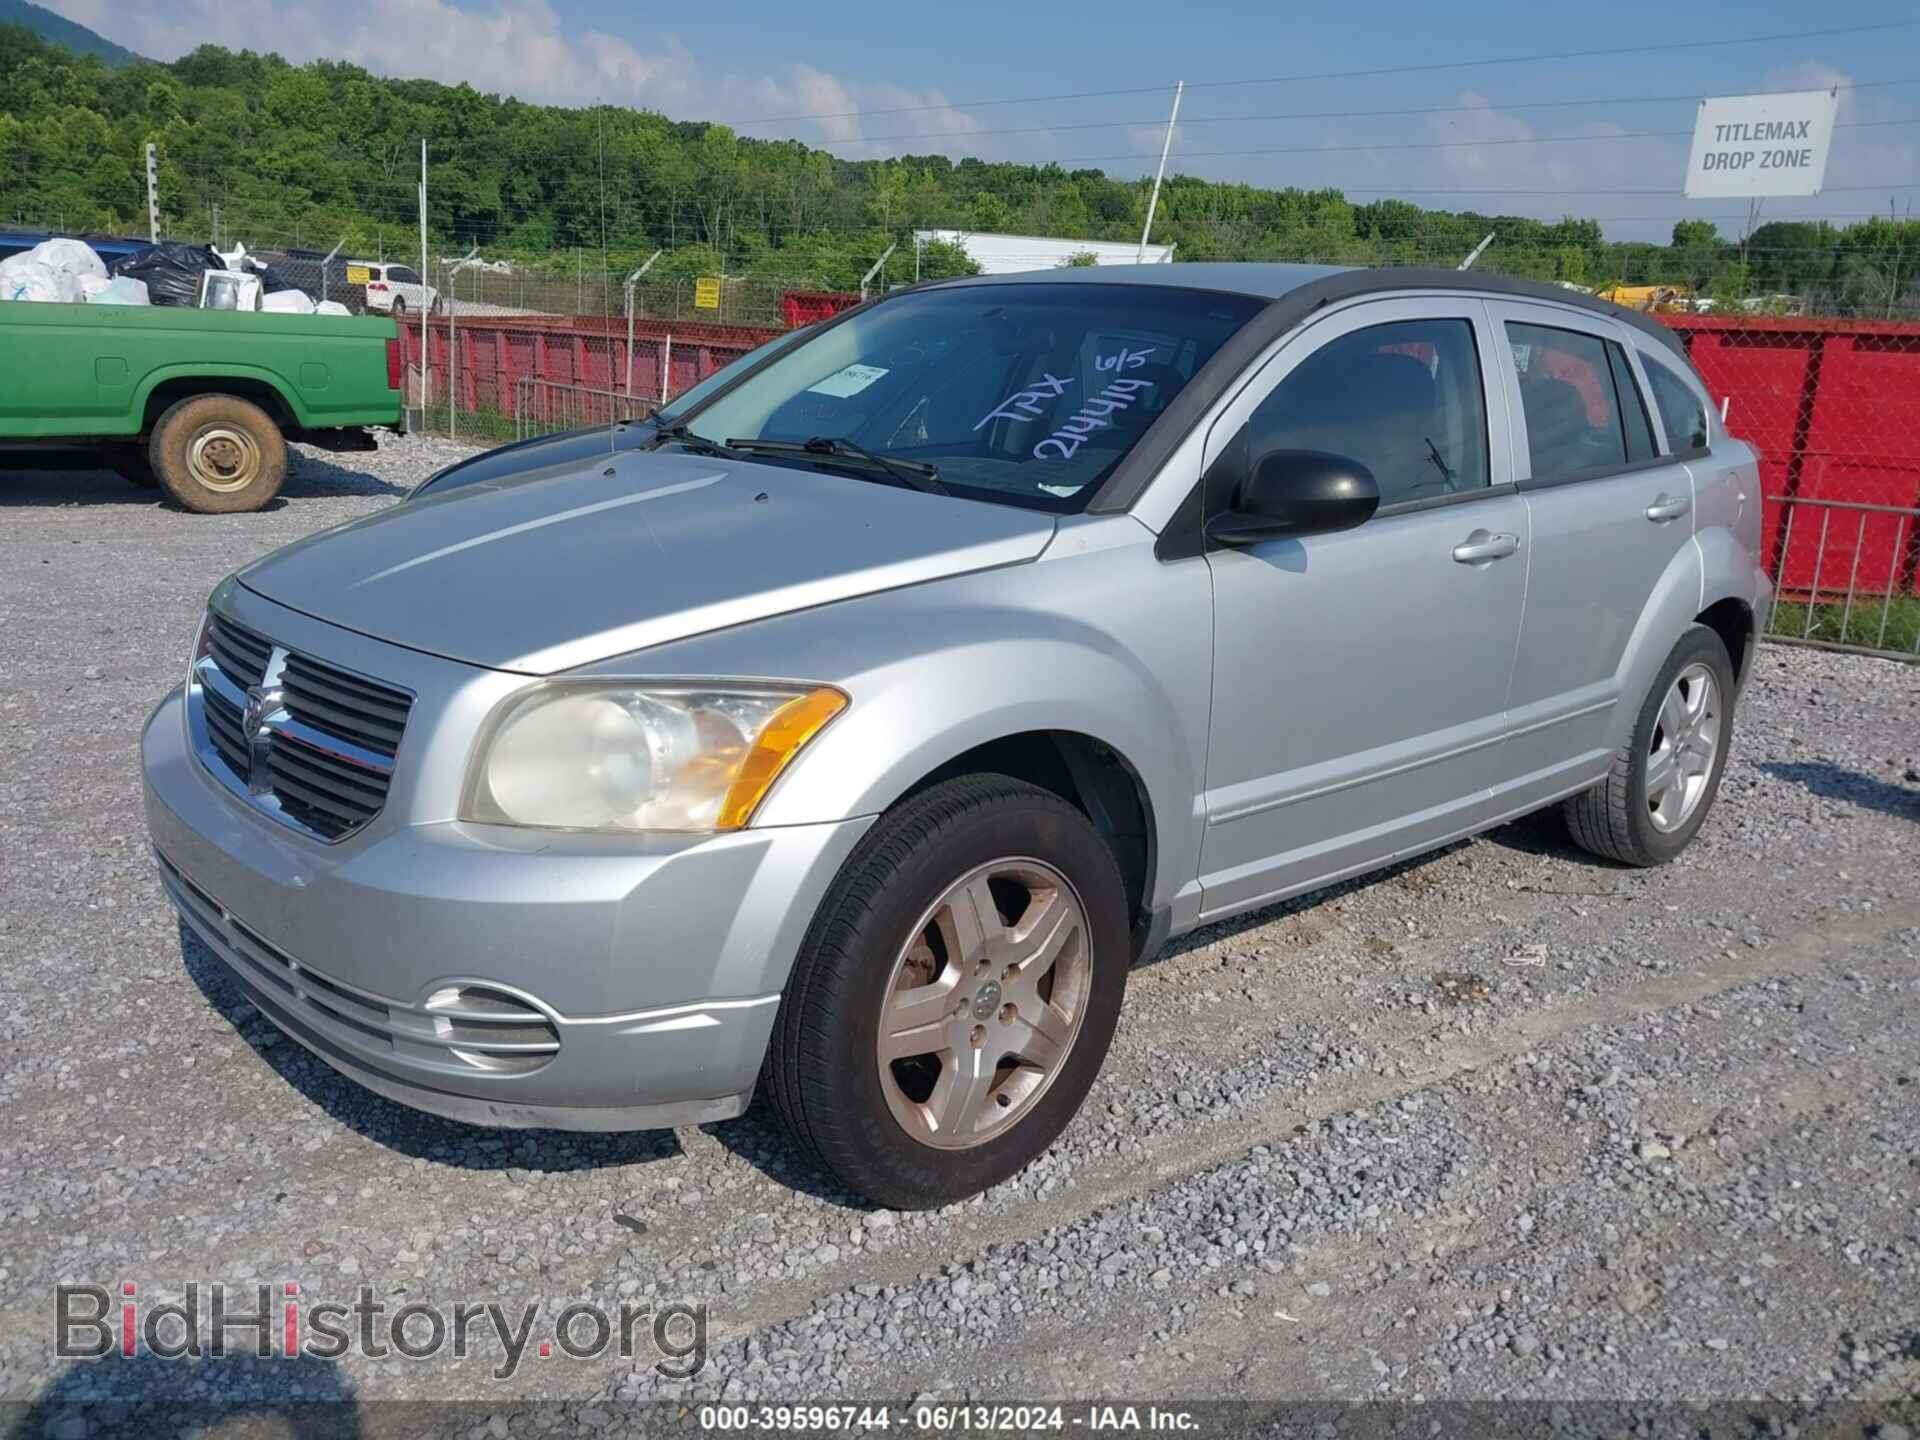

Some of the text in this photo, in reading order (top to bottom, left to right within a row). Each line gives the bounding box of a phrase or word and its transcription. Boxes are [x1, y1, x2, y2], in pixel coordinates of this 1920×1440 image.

[1715, 120, 1812, 142] TITLEMAX
[1703, 149, 1812, 170] DROP ZONE
[972, 373, 1076, 432] TAX
